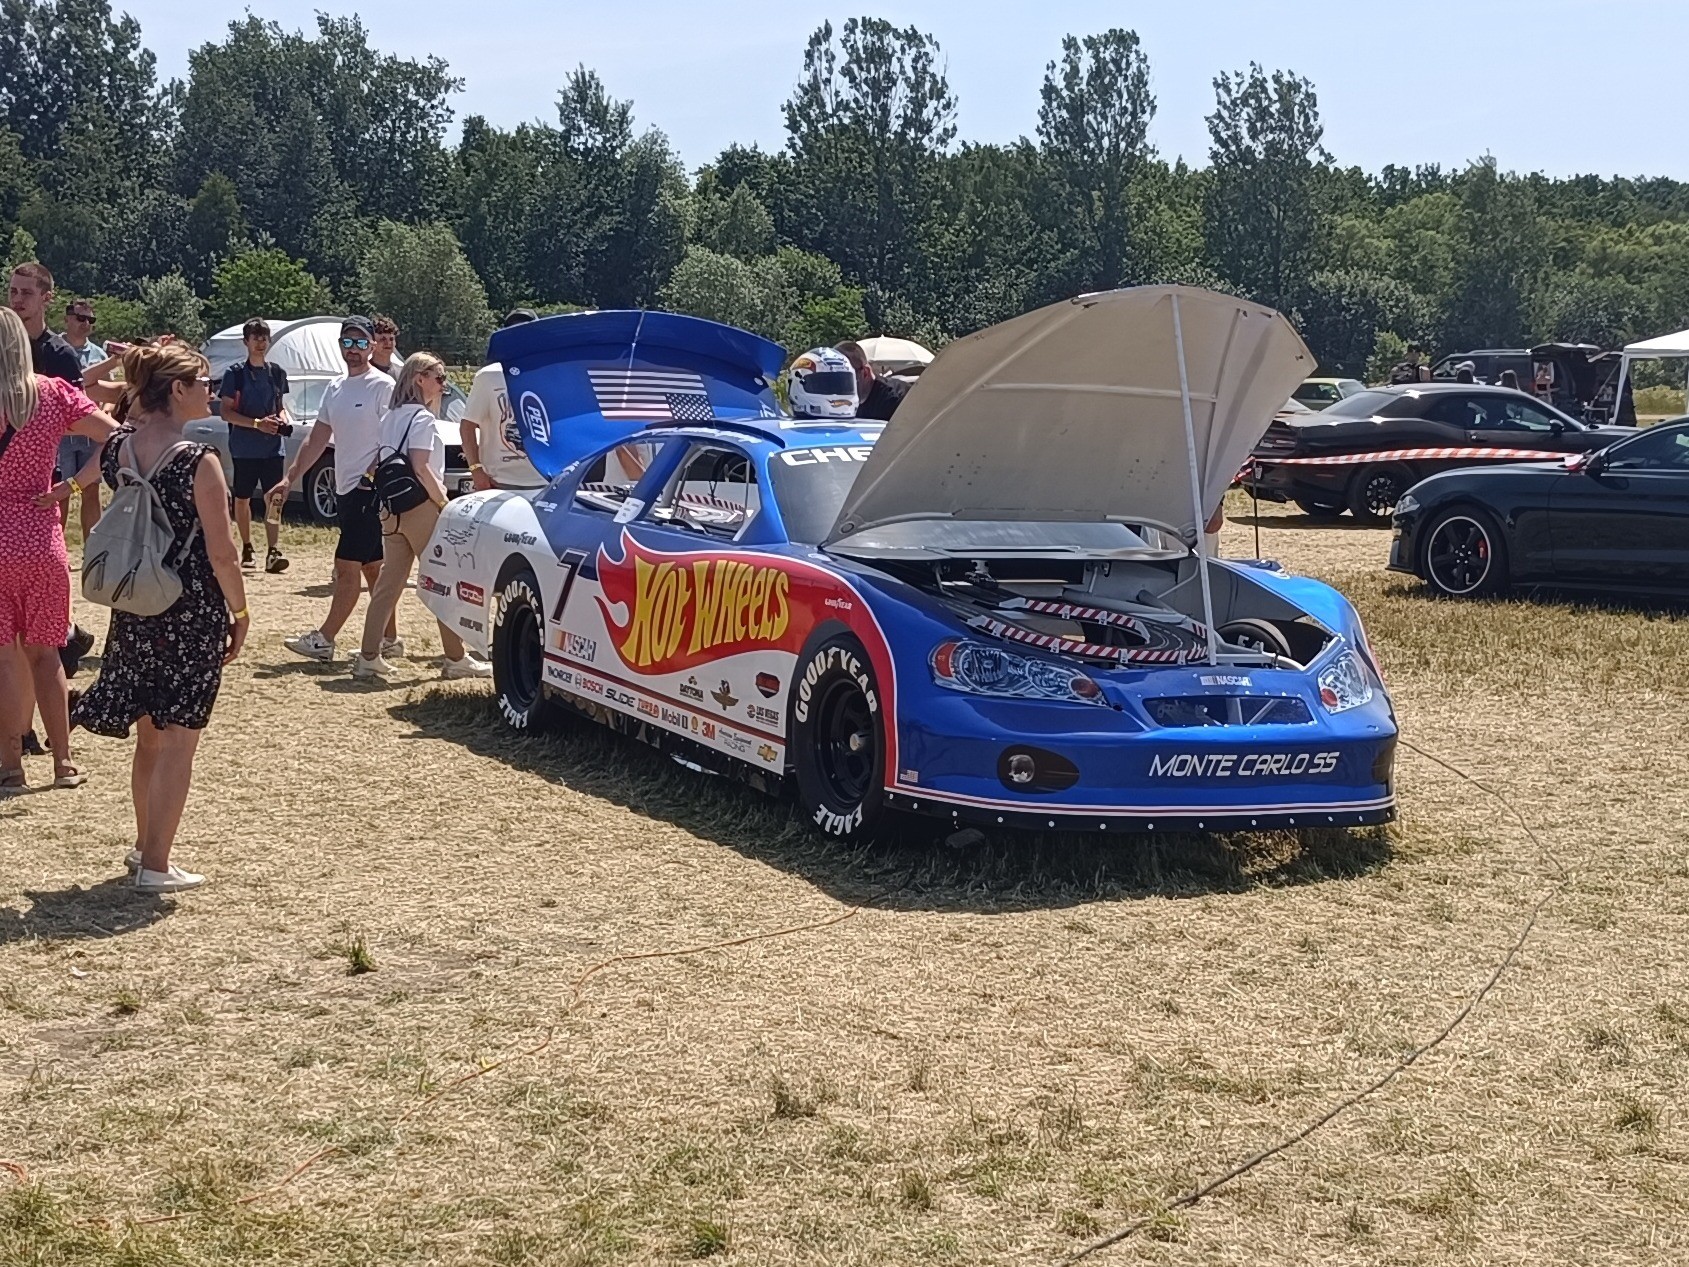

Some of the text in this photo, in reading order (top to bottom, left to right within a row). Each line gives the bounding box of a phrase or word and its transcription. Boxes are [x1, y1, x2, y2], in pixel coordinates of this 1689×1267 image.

[549, 548, 590, 625] 7
[620, 554, 789, 667] HOT WHEELS
[795, 646, 878, 723] GOODYEAR
[1215, 675, 1253, 687] NASCAR
[702, 721, 716, 740] 3M
[1149, 751, 1340, 777] MONTE CARLO SS
[813, 802, 863, 836] EAGLE
